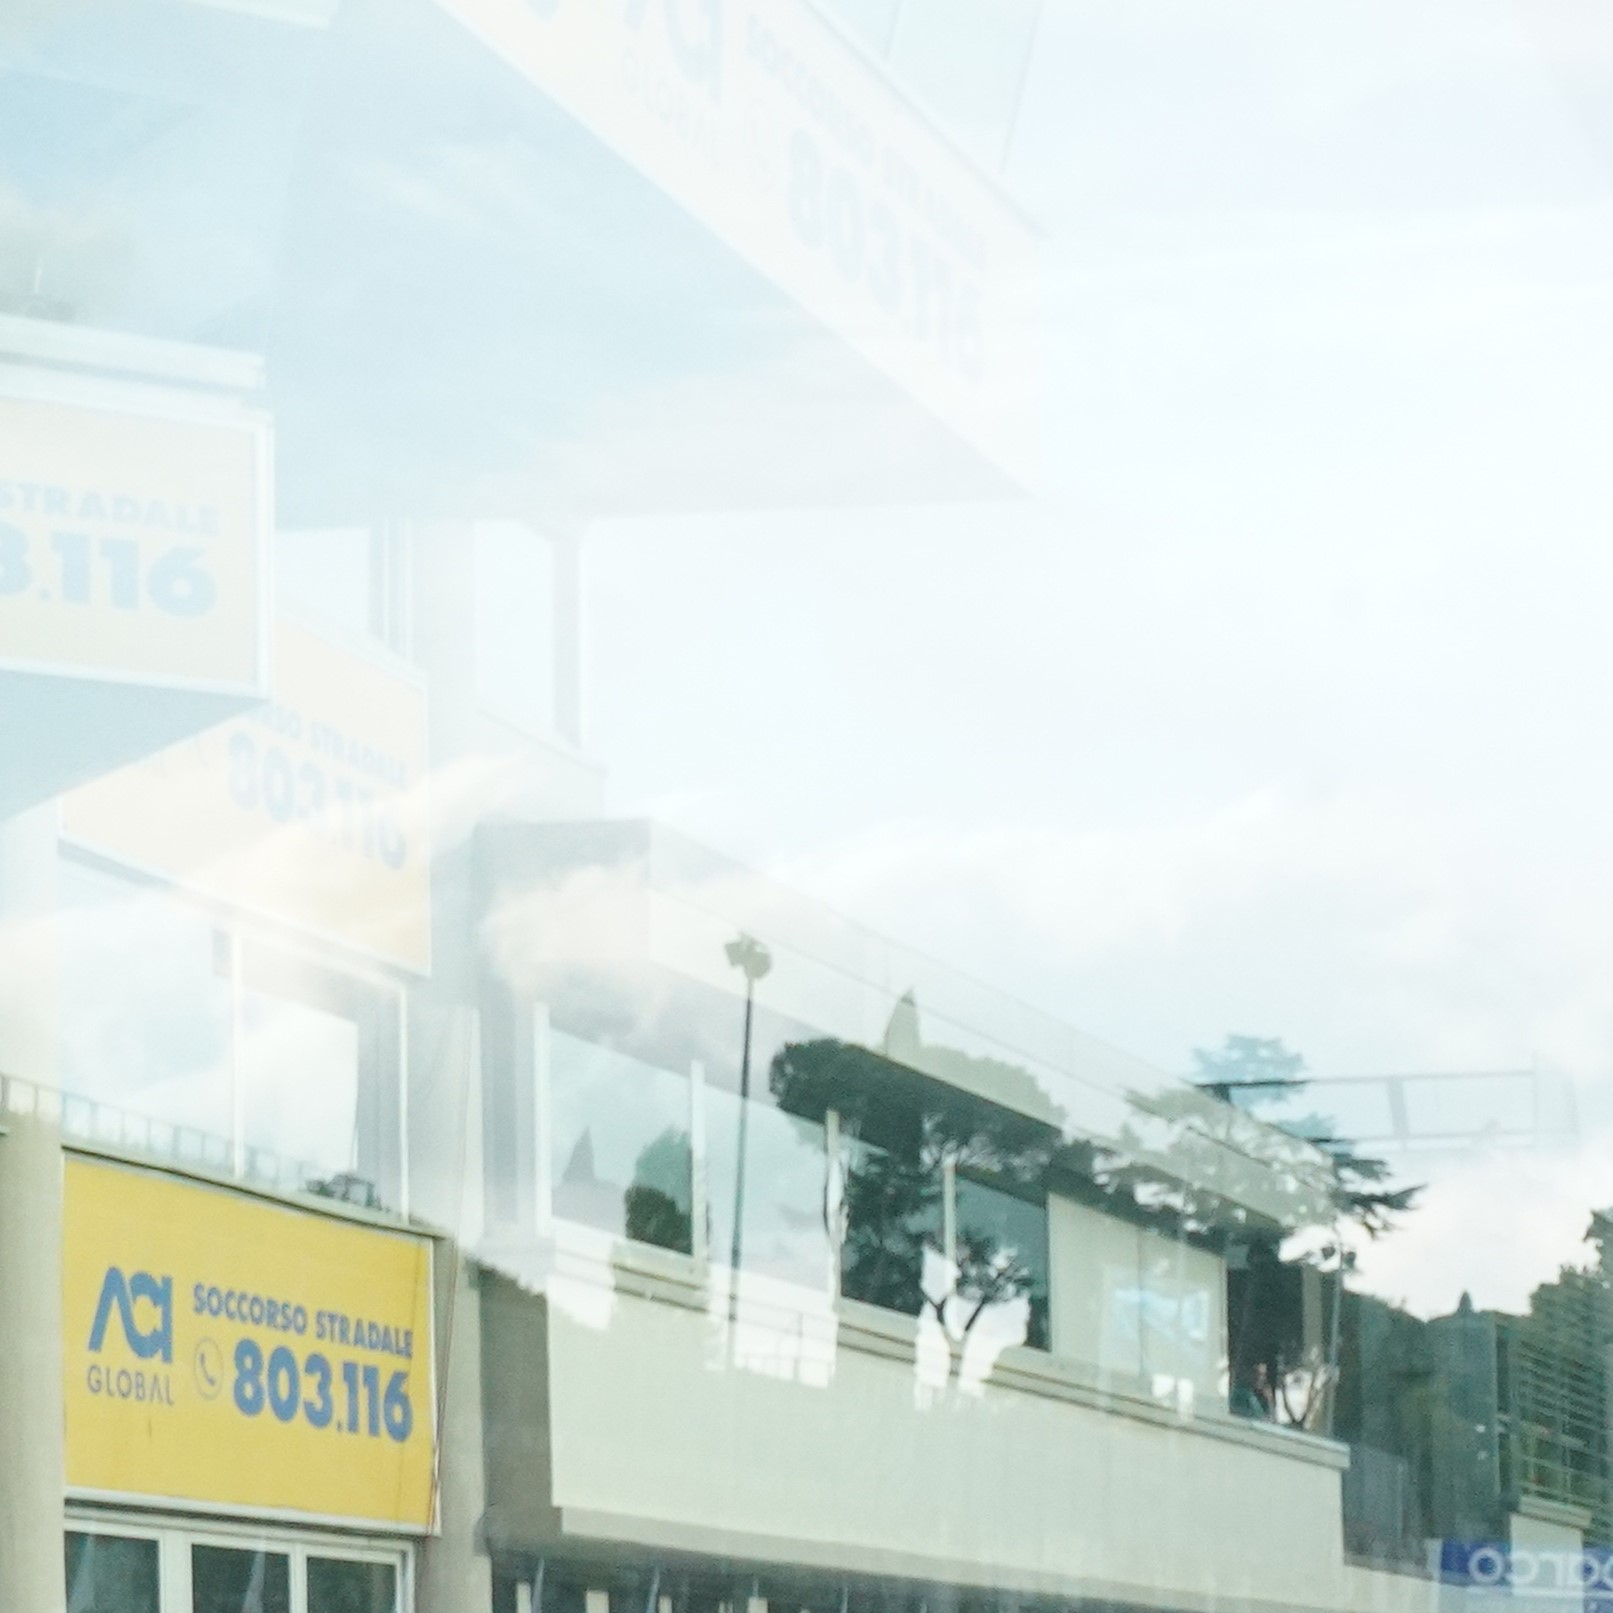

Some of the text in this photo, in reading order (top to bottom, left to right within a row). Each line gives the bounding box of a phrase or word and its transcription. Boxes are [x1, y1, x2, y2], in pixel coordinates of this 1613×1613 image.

[0, 516, 219, 625] 3.116
[193, 1283, 414, 1360] SOCCORSO STRADALE
[87, 1364, 175, 1407] GLOBAL
[233, 1337, 414, 1443] 803.116
